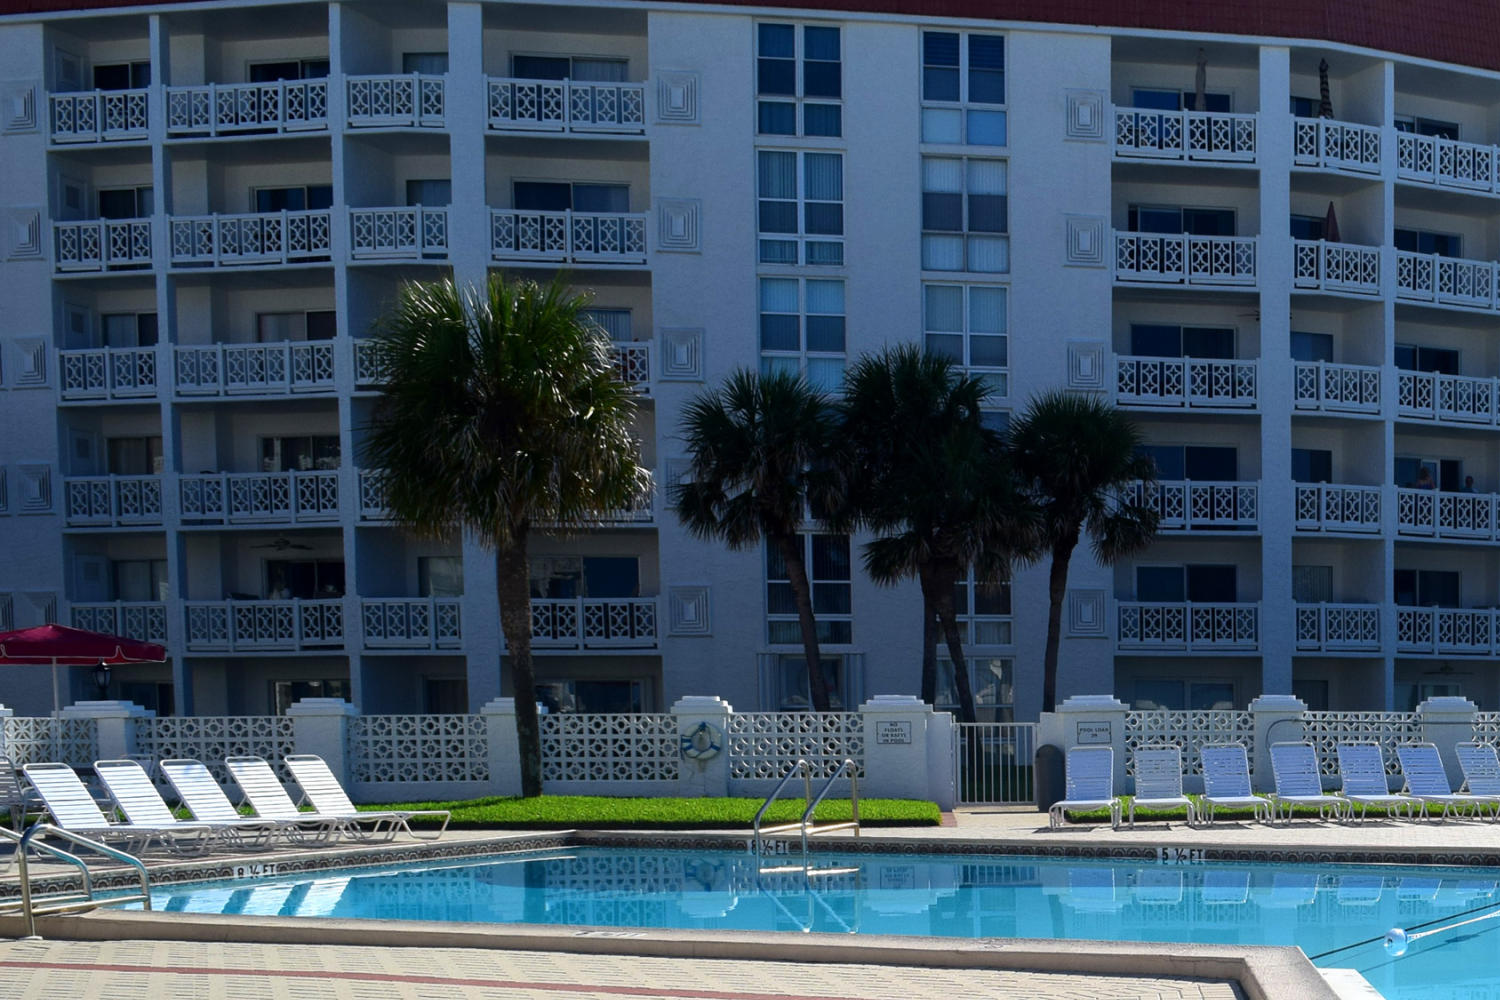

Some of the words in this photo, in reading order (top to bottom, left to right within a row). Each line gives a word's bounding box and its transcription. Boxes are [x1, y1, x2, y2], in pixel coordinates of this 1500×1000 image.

[775, 840, 788, 852] FT
[1161, 847, 1169, 861] 5
[1189, 848, 1204, 860] FT
[262, 863, 276, 874] FT
